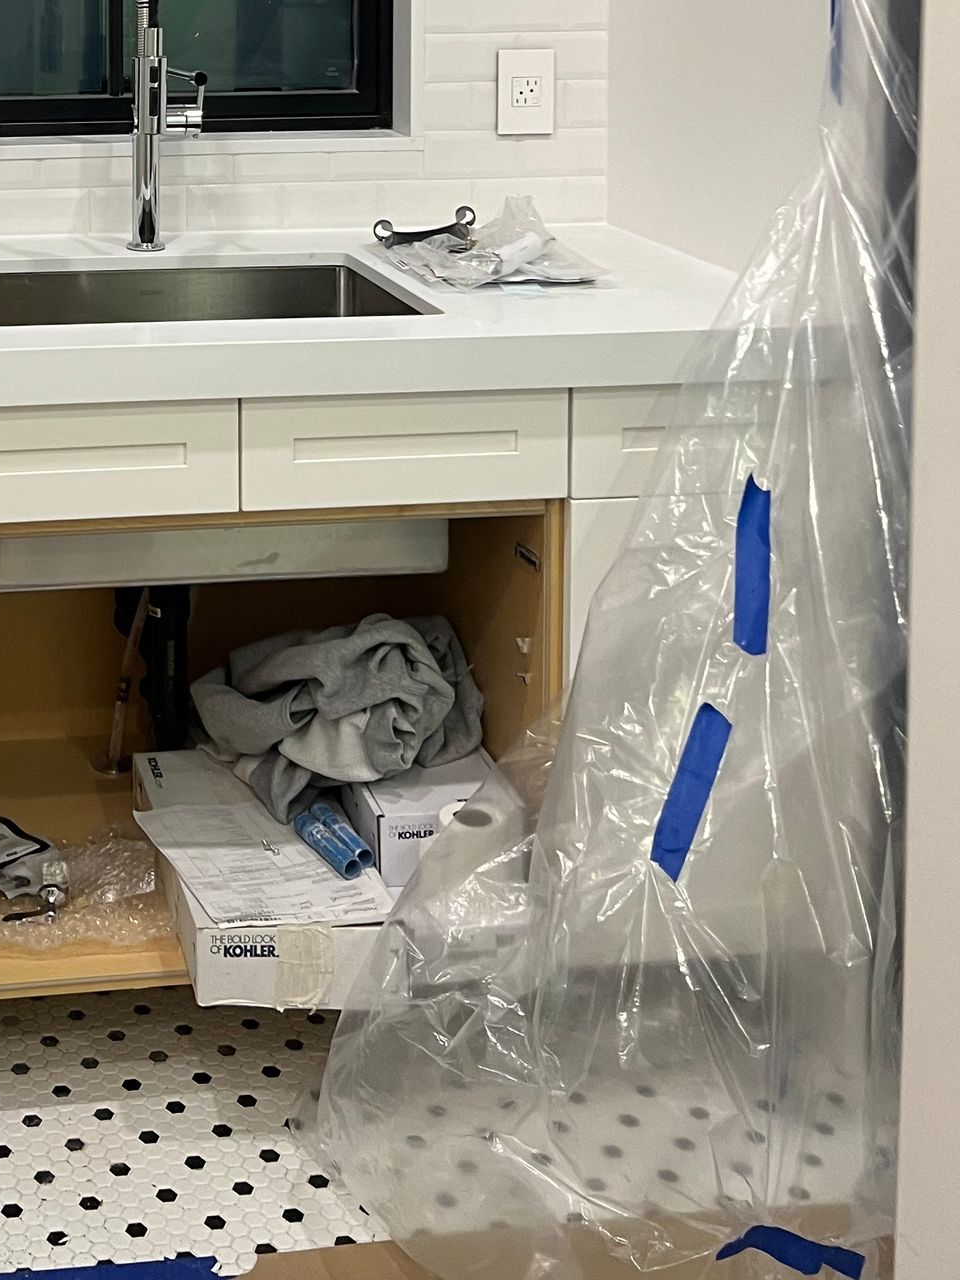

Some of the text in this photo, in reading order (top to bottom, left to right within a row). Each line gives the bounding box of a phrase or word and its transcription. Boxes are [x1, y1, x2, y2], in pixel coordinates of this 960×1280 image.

[210, 934, 276, 945] THE BOLD LOOK
[210, 944, 222, 955] OF
